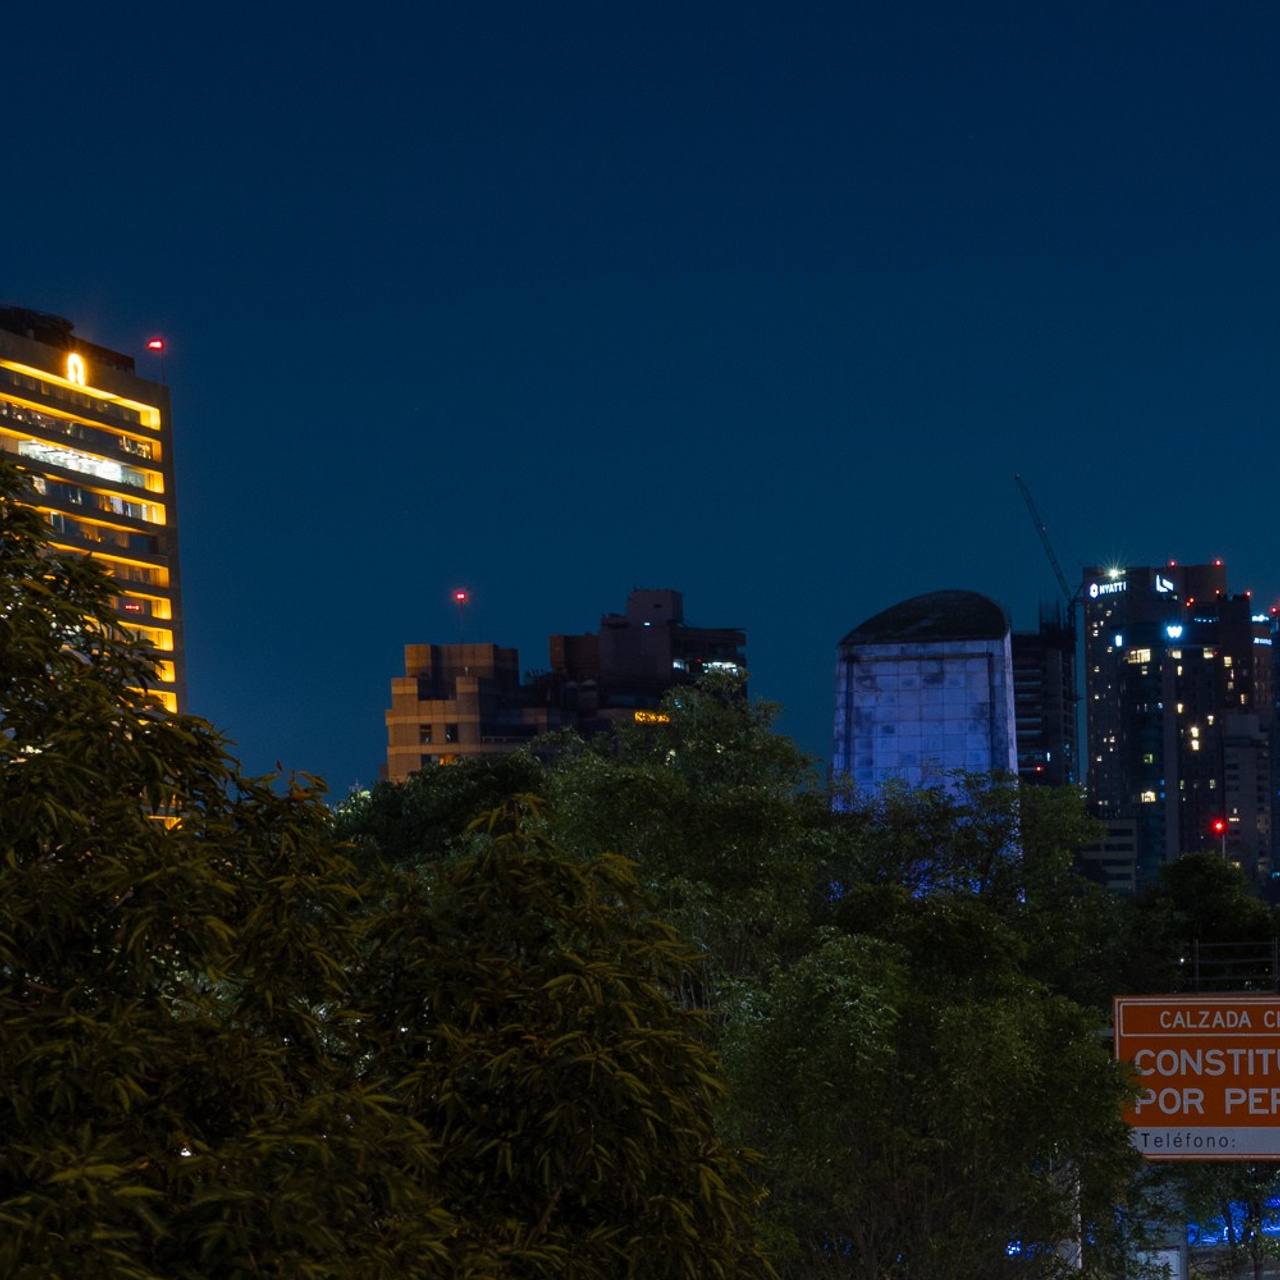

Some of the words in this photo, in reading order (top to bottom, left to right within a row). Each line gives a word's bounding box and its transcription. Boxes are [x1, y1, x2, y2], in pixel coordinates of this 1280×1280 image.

[1160, 1010, 1252, 1028] CALZADA
[1135, 1087, 1204, 1114] POR
[1141, 1131, 1236, 1149] Teléfono:
